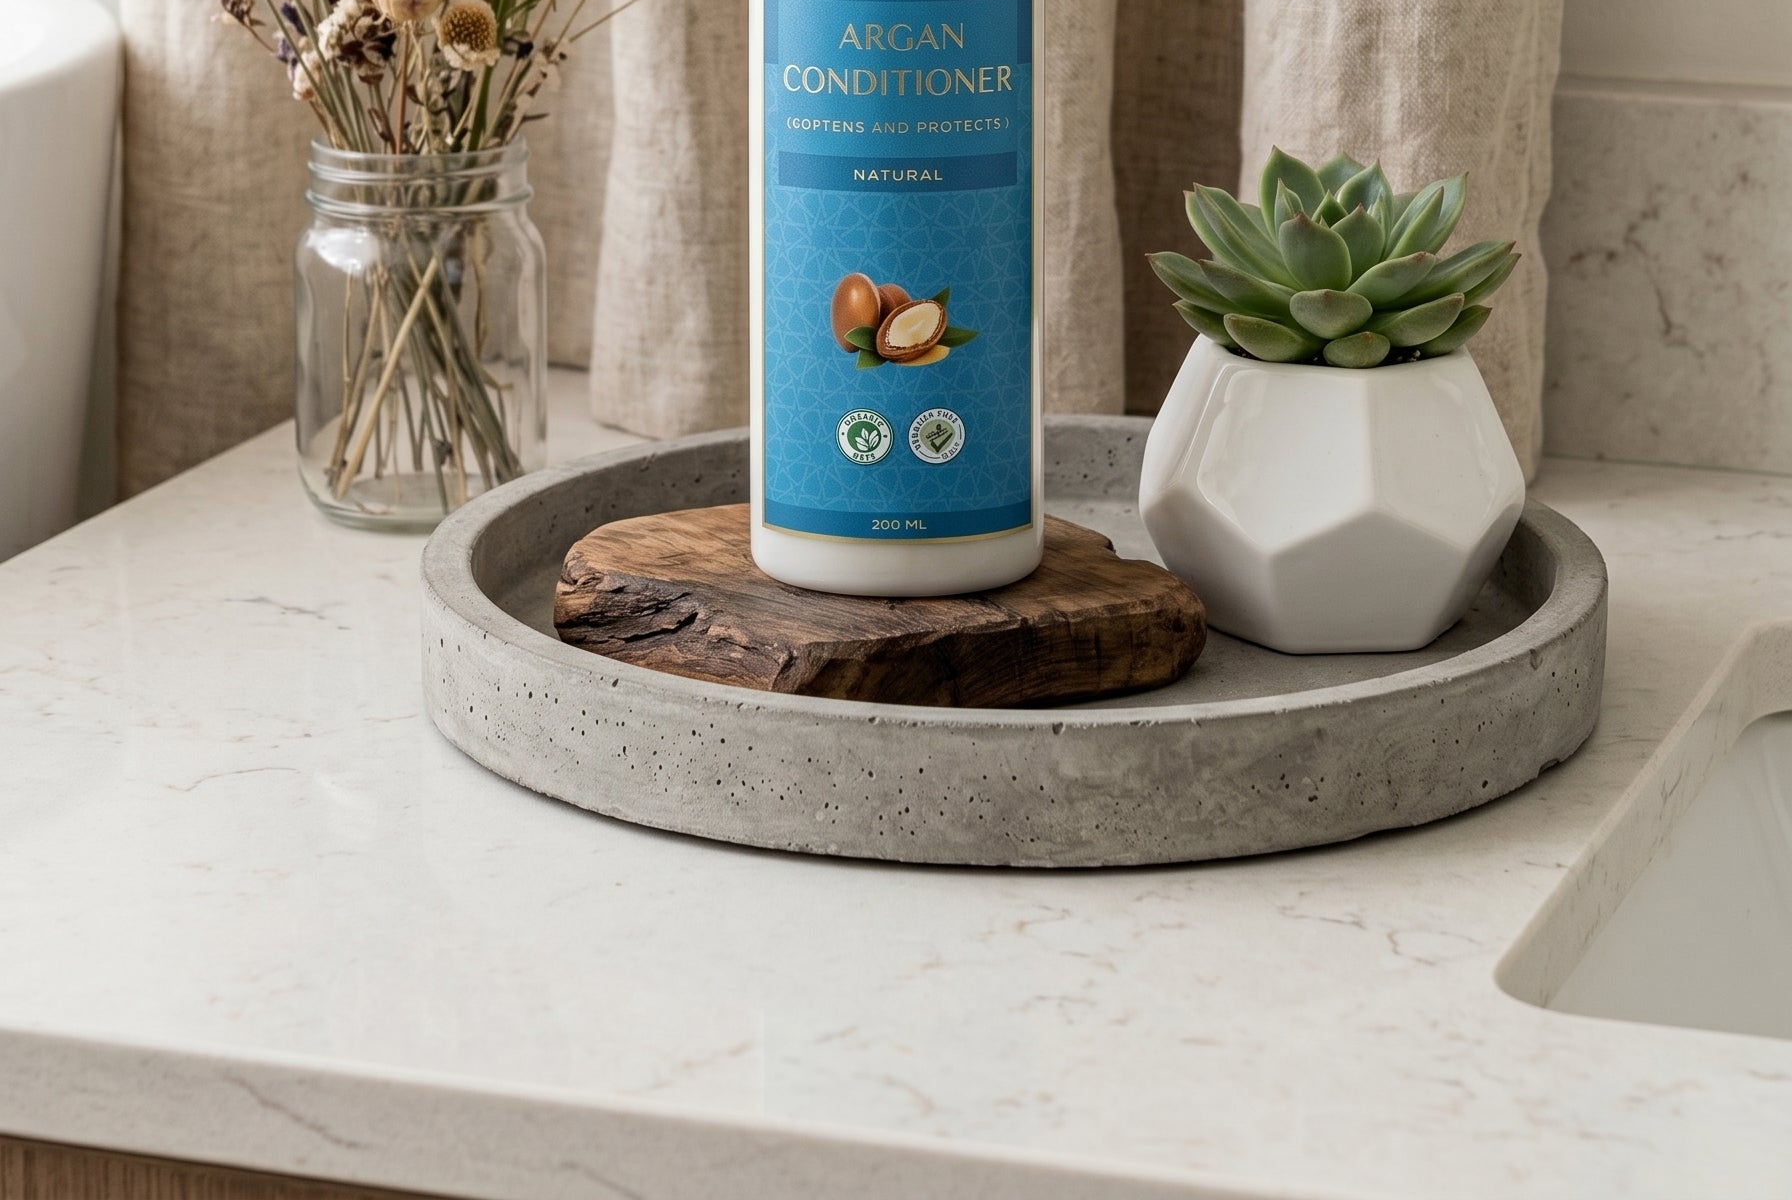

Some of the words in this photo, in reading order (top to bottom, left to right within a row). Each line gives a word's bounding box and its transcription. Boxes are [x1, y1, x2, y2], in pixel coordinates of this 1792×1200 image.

[838, 23, 965, 51] ARGAN
[783, 64, 1014, 96] CONDITIONER
[871, 121, 909, 134] AND
[853, 169, 943, 182] NATURAL
[871, 519, 900, 530] 200
[905, 519, 928, 530] ML
